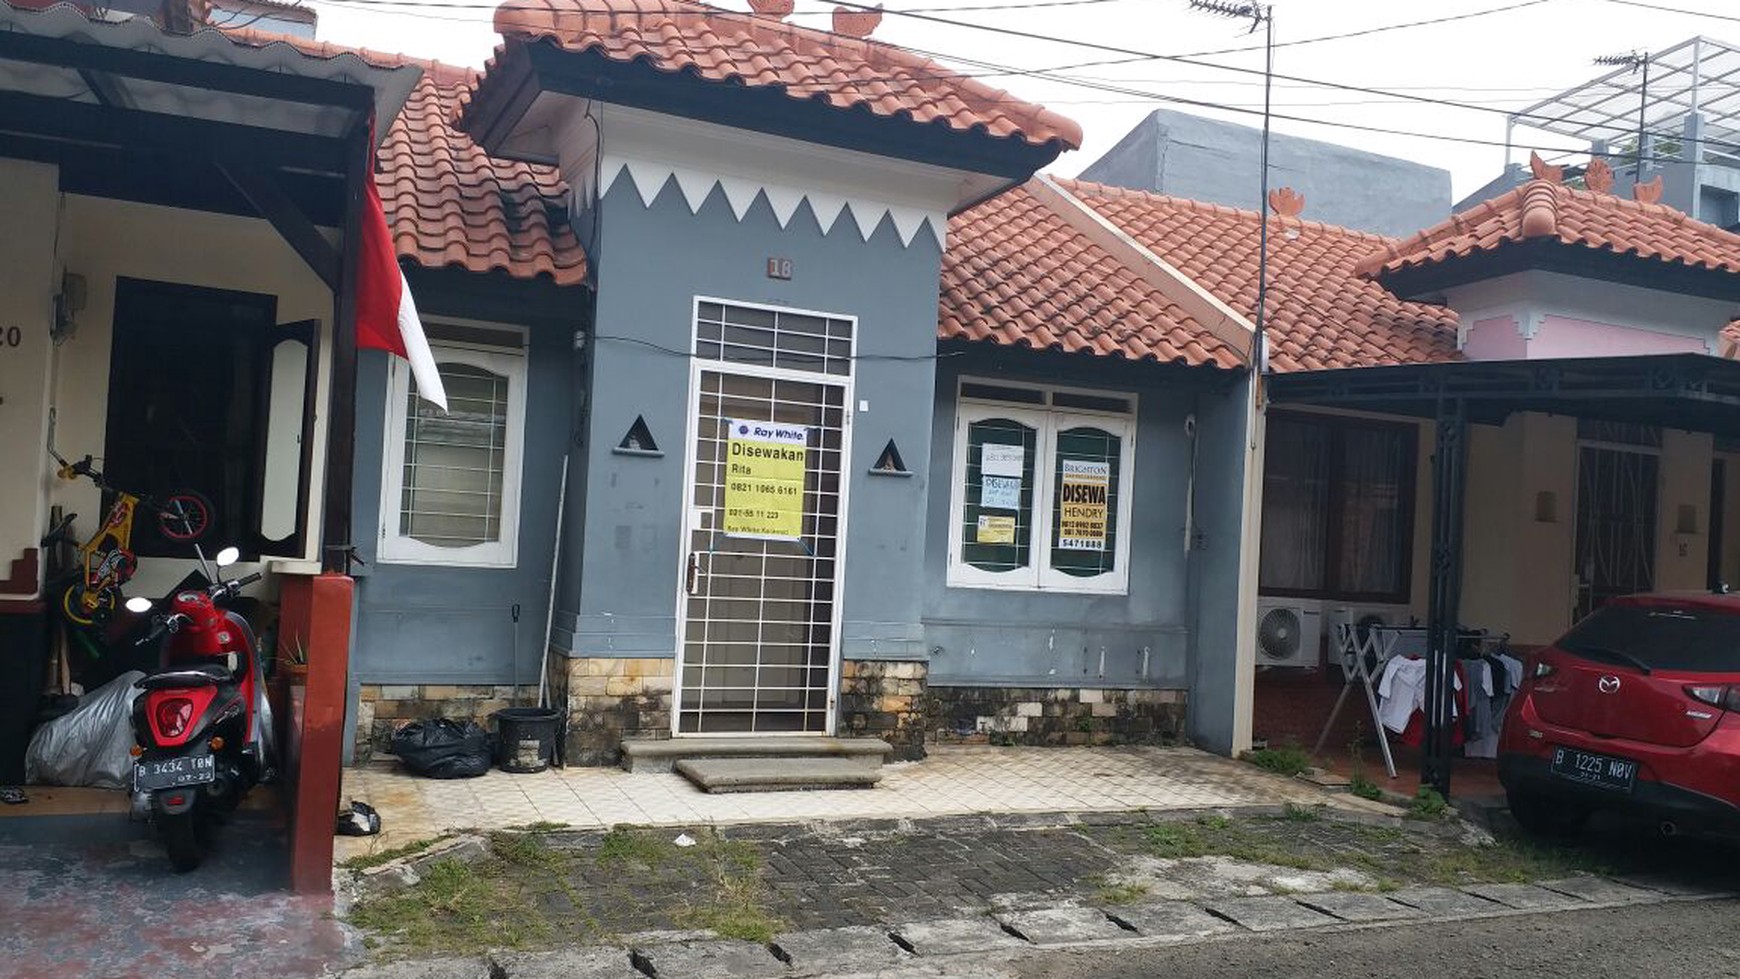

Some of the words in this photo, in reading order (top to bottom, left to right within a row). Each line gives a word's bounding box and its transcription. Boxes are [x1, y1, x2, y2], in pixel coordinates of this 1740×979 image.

[769, 259, 791, 278] 18
[753, 427, 774, 438] Ray
[731, 442, 804, 461] Disewakan
[731, 464, 752, 475] Rita
[1065, 464, 1107, 474] BRIGHTON
[731, 483, 752, 492] 0821
[1063, 484, 1106, 504] DISEWA
[1064, 507, 1103, 518] HENDRY
[1555, 749, 1564, 764] B
[1575, 753, 1603, 773] 1225
[139, 766, 146, 777] B
[153, 761, 183, 774] 3434
